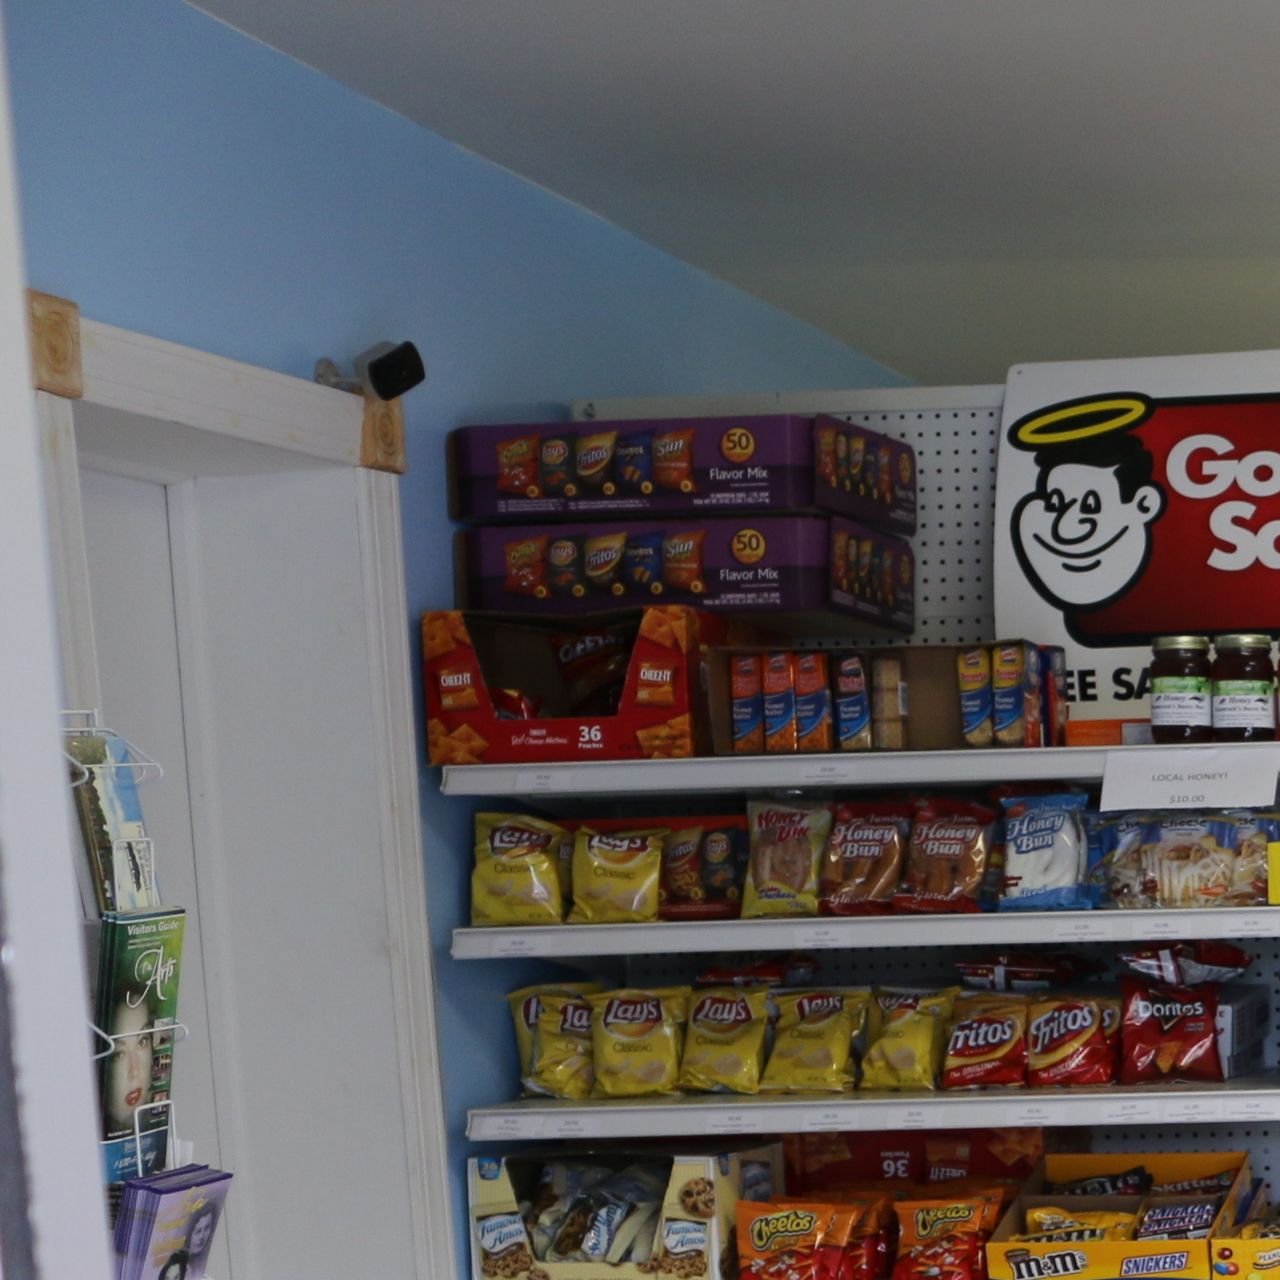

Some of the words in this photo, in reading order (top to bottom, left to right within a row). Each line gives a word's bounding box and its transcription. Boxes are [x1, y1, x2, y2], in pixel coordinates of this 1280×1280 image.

[726, 432, 750, 451] 50
[709, 468, 744, 481] Flavor
[747, 467, 768, 479] Mix
[736, 534, 760, 552] 50
[720, 569, 755, 581] Flavor
[758, 568, 779, 580] Mix
[1163, 693, 1187, 703] Honey
[1228, 696, 1252, 706] Honey
[578, 726, 602, 741] 36
[1151, 774, 1184, 782] LOCAL
[1187, 772, 1229, 781] HONEY!
[1168, 795, 1205, 805] $10.00
[1007, 814, 1065, 840] Honey
[1161, 817, 1208, 829] Cheese
[834, 826, 895, 844] Honey
[915, 826, 977, 844] Honey
[841, 842, 880, 857] Bun
[925, 842, 962, 856] Bun
[1015, 835, 1054, 854] Bun
[127, 922, 156, 936] Visitors
[158, 920, 180, 932] Guide
[1138, 1001, 1204, 1017] Doritos
[950, 1019, 1013, 1050] Fritos
[1031, 1005, 1094, 1053] Fritos
[613, 1042, 654, 1053] Classic
[882, 1160, 909, 1178] 36
[751, 1213, 815, 1246] Cheetos
[917, 1206, 972, 1237] Cheetos
[493, 1228, 525, 1245] Amos
[675, 1236, 706, 1248] Amos
[1123, 1254, 1186, 1275] SNICKERS
